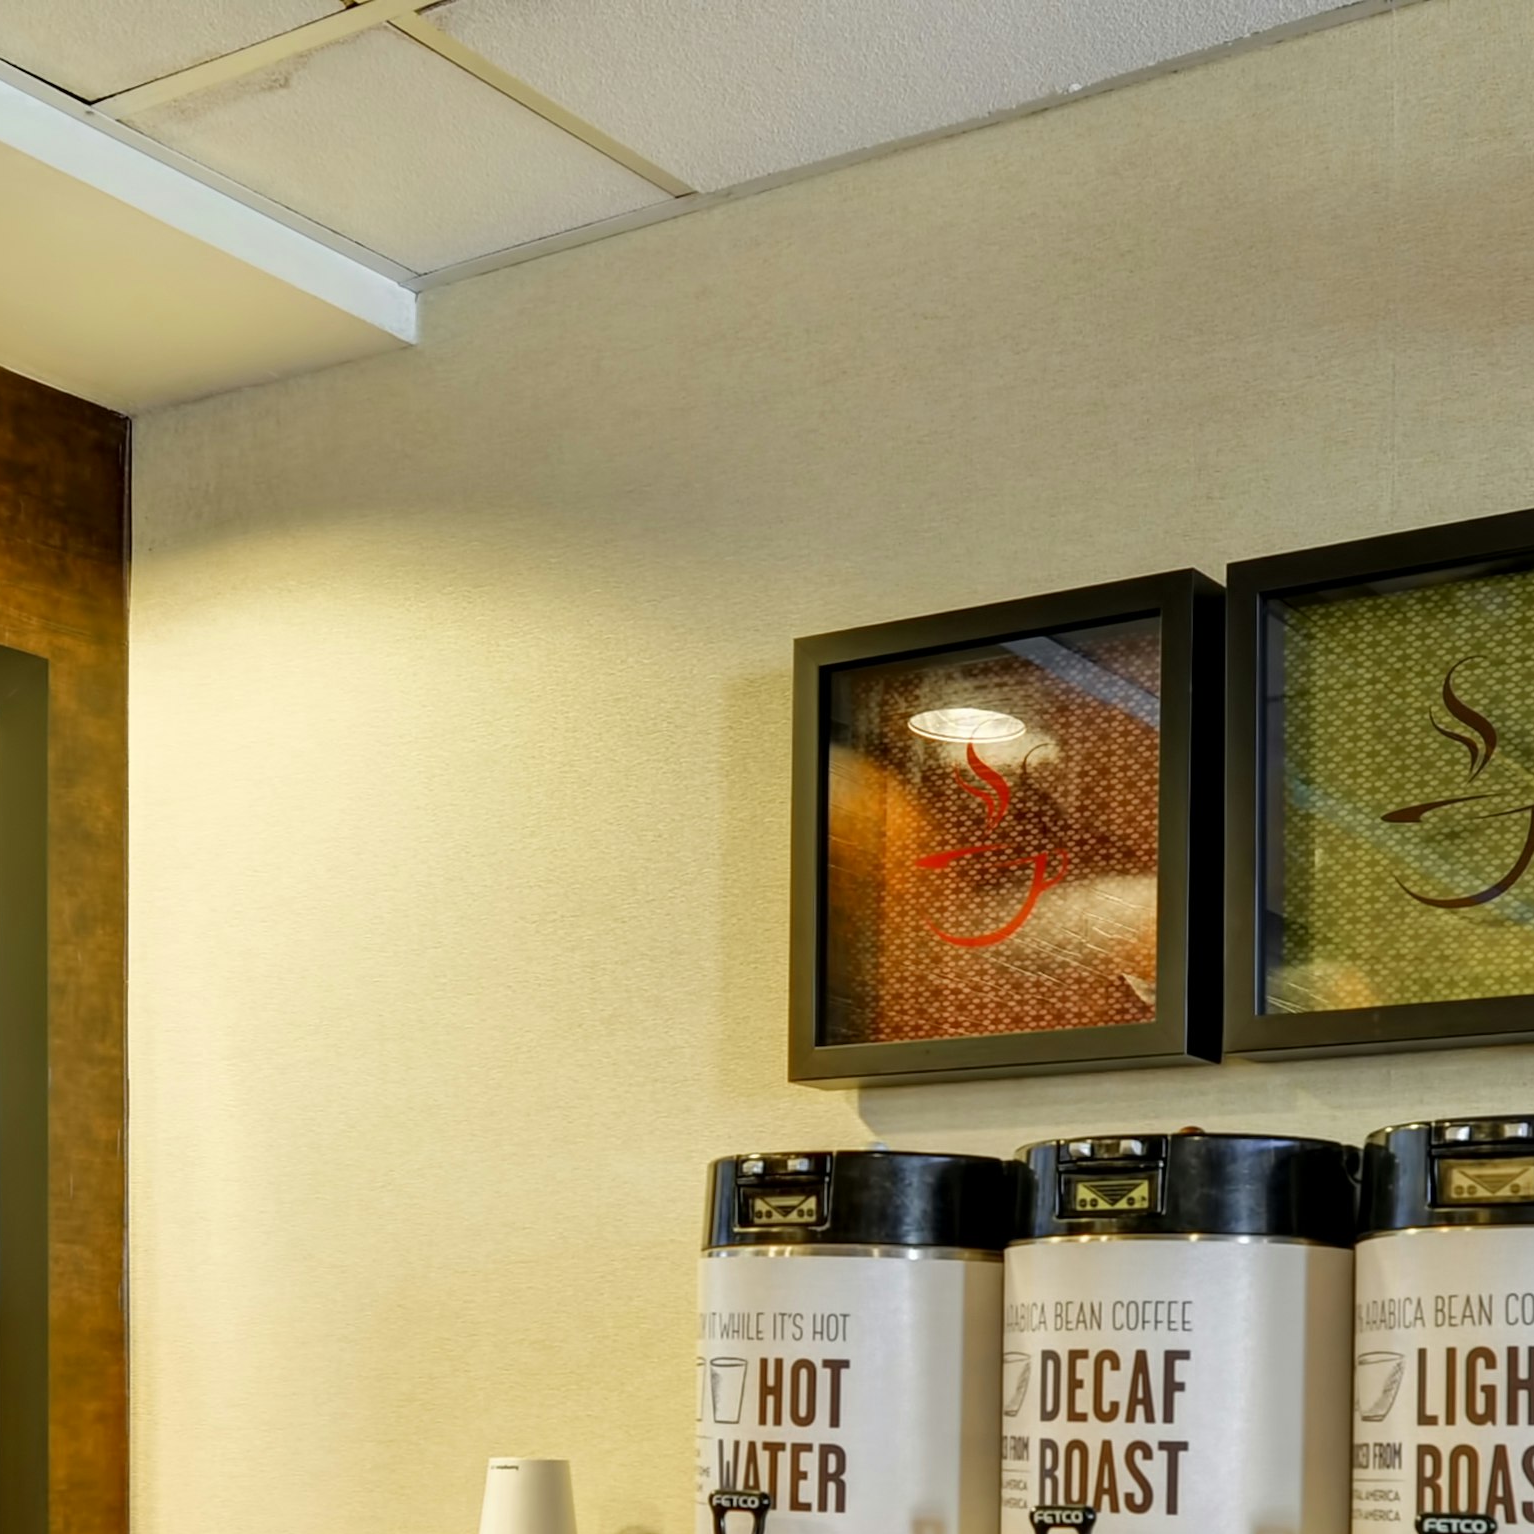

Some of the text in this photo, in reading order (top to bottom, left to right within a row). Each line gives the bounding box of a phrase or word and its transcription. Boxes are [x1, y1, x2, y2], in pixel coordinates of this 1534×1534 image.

[718, 1312, 766, 1341] WHILE
[772, 1312, 804, 1342] IT'S
[812, 1313, 851, 1342] HOT
[1053, 1300, 1103, 1332] BEAN
[1111, 1300, 1194, 1333] COFFEE
[1365, 1297, 1426, 1332] ARABICA
[1433, 1294, 1494, 1328] BEAN
[758, 1357, 851, 1429] HOT
[1039, 1349, 1191, 1425] DECAF
[1373, 1442, 1403, 1470] FROM
[717, 1438, 848, 1514] WATER
[1038, 1438, 1190, 1516] ROAST
[712, 1495, 760, 1509] FETCO
[1032, 1510, 1084, 1525] FETCO
[1423, 1518, 1488, 1534] FETCO
